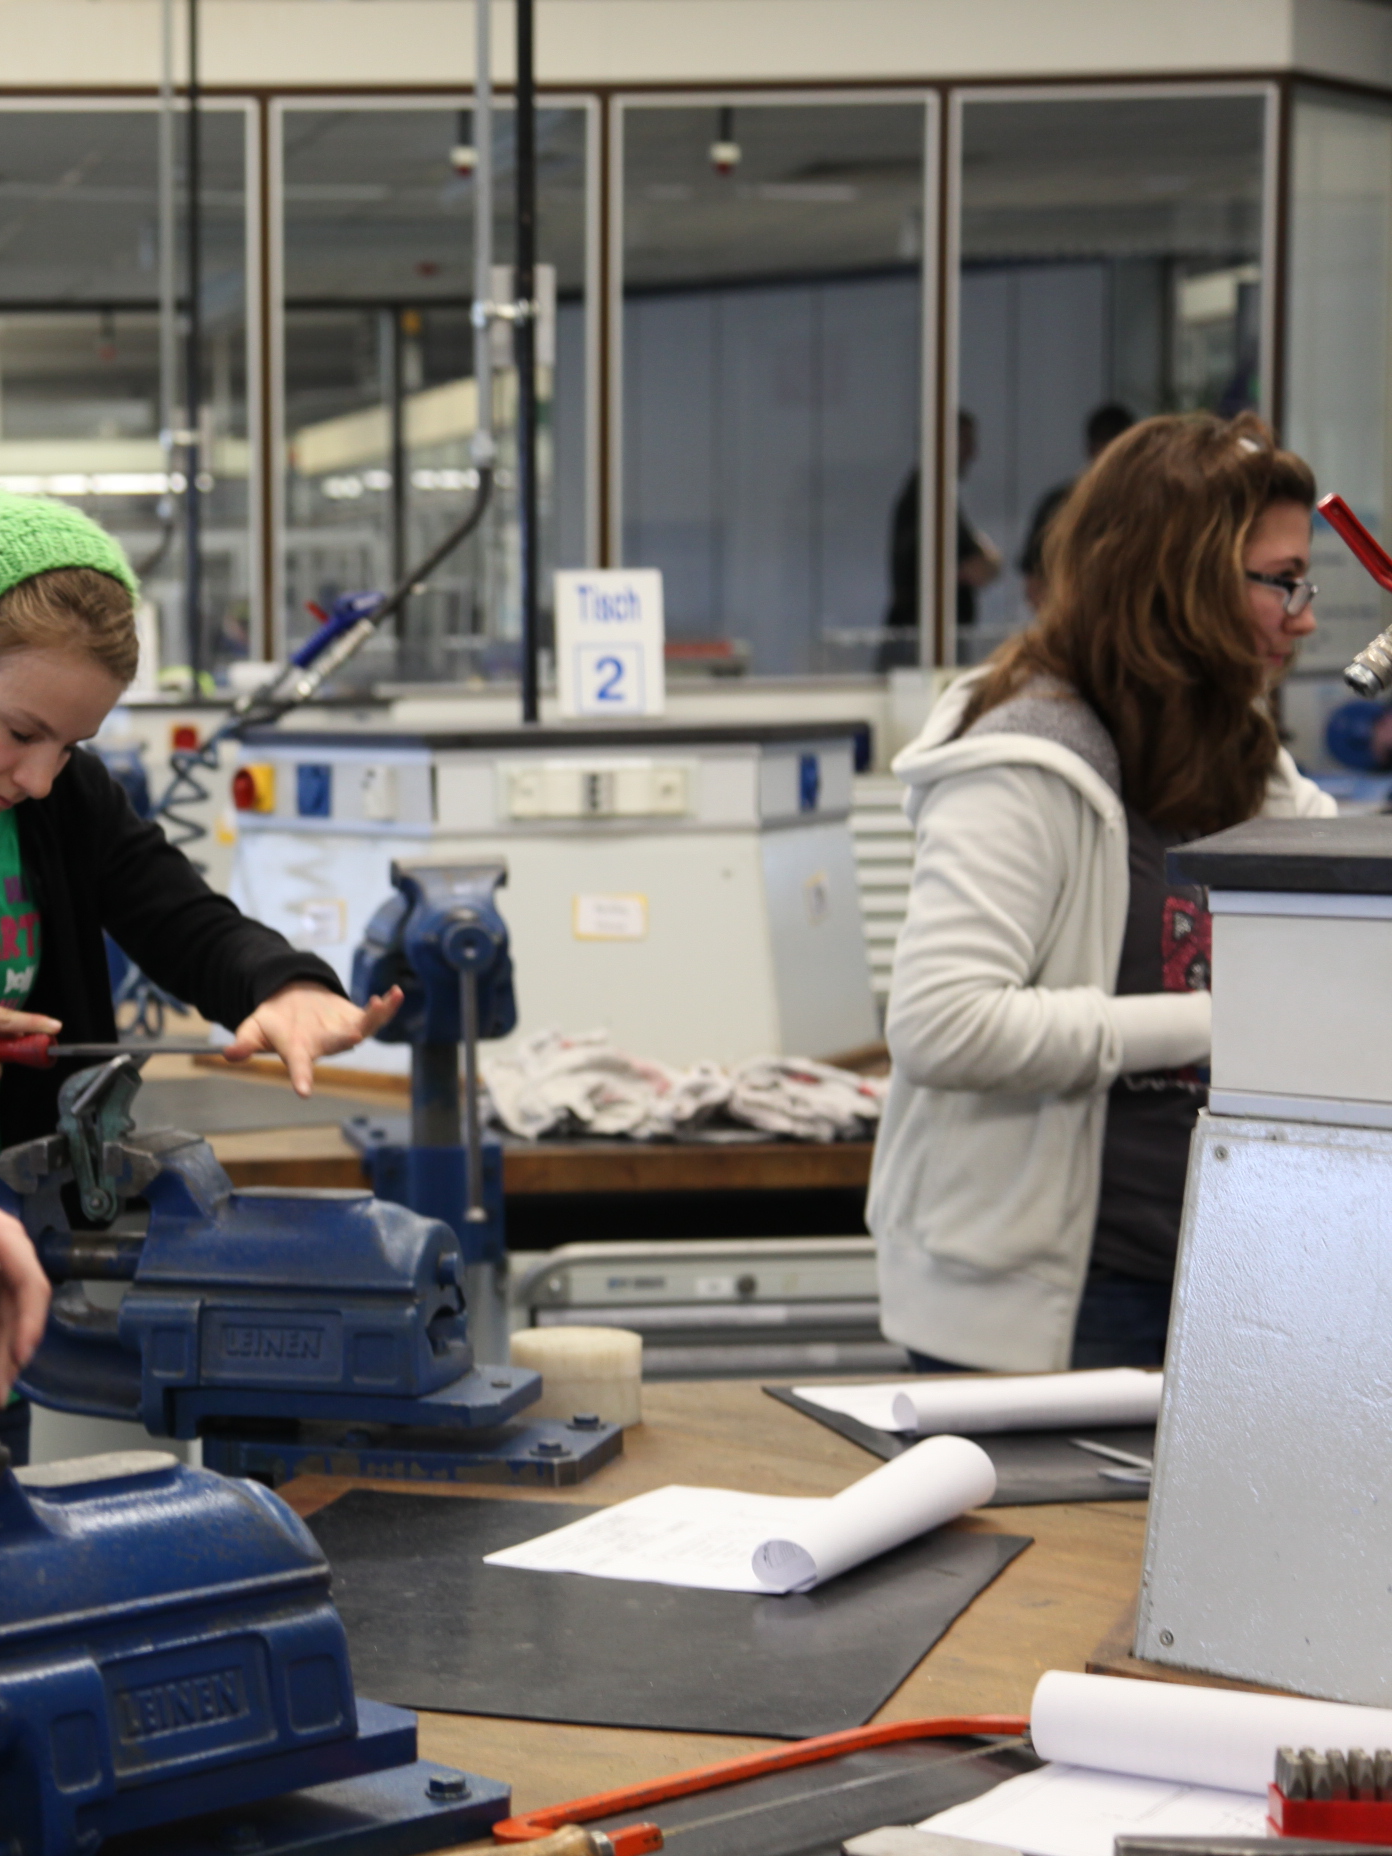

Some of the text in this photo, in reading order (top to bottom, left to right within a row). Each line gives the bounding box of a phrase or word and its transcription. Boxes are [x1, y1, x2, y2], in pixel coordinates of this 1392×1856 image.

[577, 583, 642, 622] Tisch
[595, 655, 625, 701] 2
[220, 1326, 322, 1359] LEINEN
[118, 1668, 243, 1740] LEINEN
